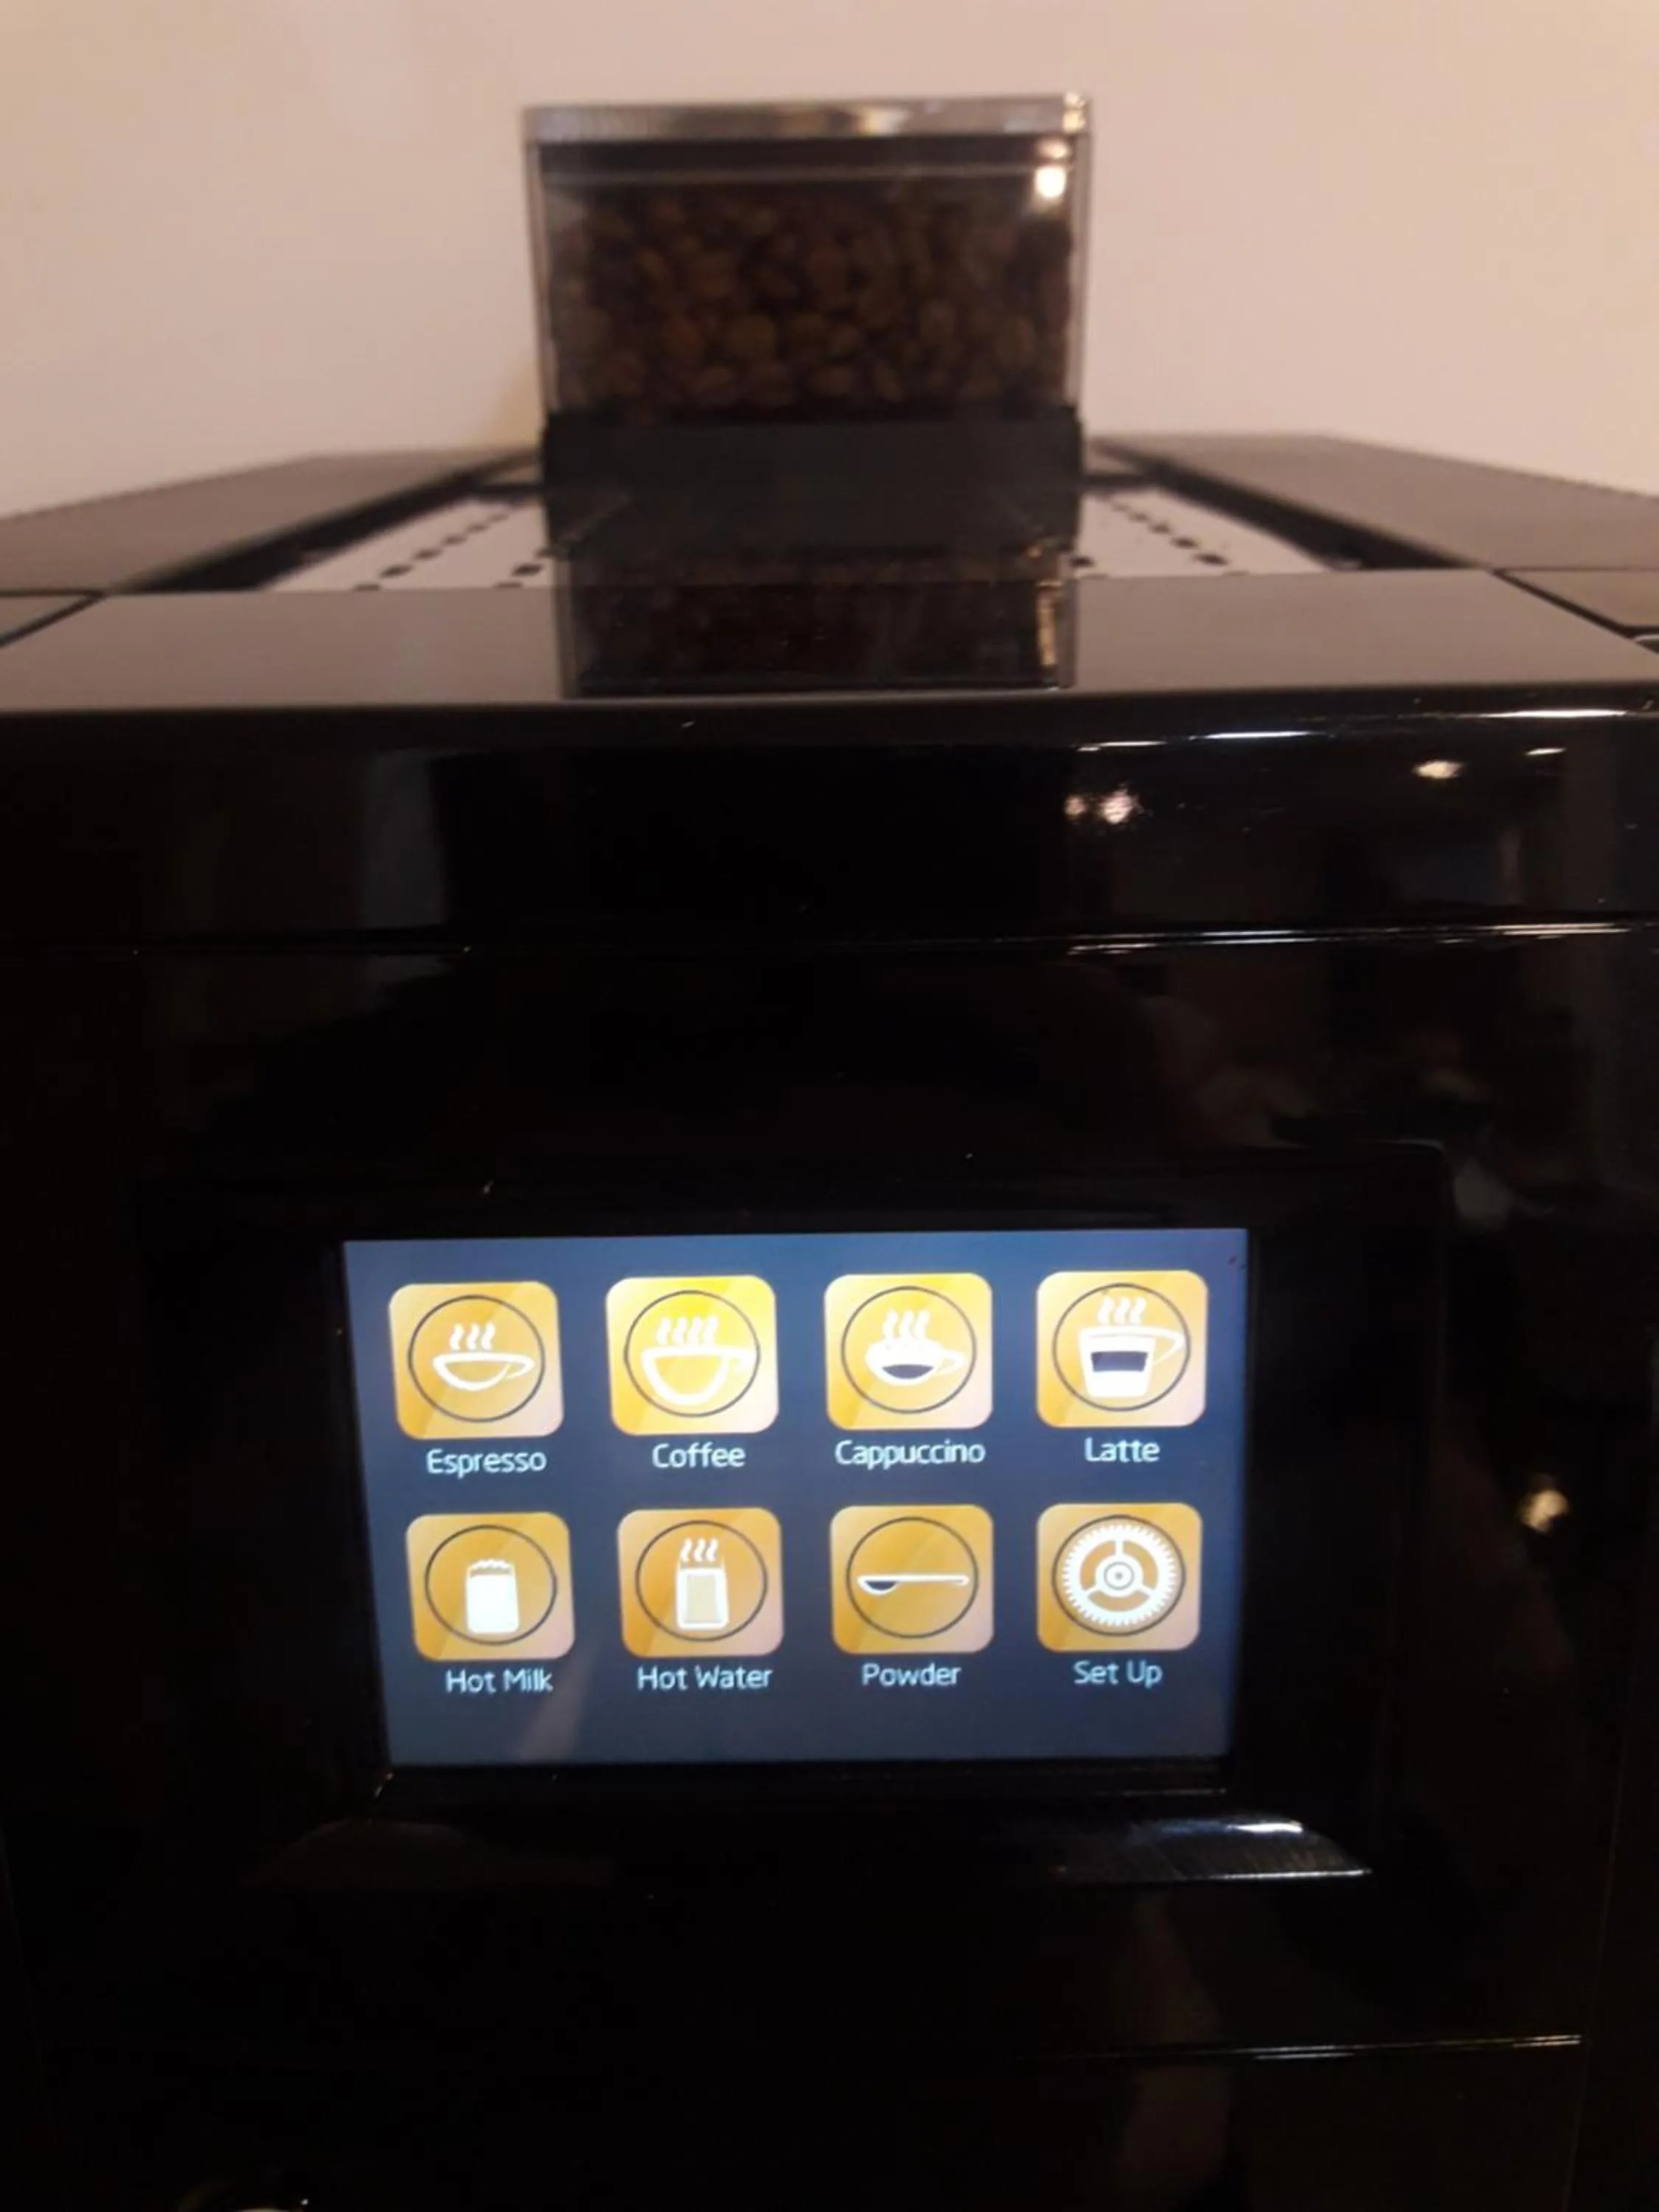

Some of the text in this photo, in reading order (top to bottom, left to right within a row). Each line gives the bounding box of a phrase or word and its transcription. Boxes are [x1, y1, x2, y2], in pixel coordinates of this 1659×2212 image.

[425, 1447, 548, 1479] Espresso
[651, 1441, 747, 1470] Coffee
[834, 1438, 987, 1472] Cappuccino
[1085, 1436, 1161, 1464] Latte
[445, 1667, 554, 1694] Hot Milk
[637, 1664, 773, 1691] Hot Water
[862, 1661, 962, 1687] Powder
[1073, 1659, 1164, 1689] Set Up
